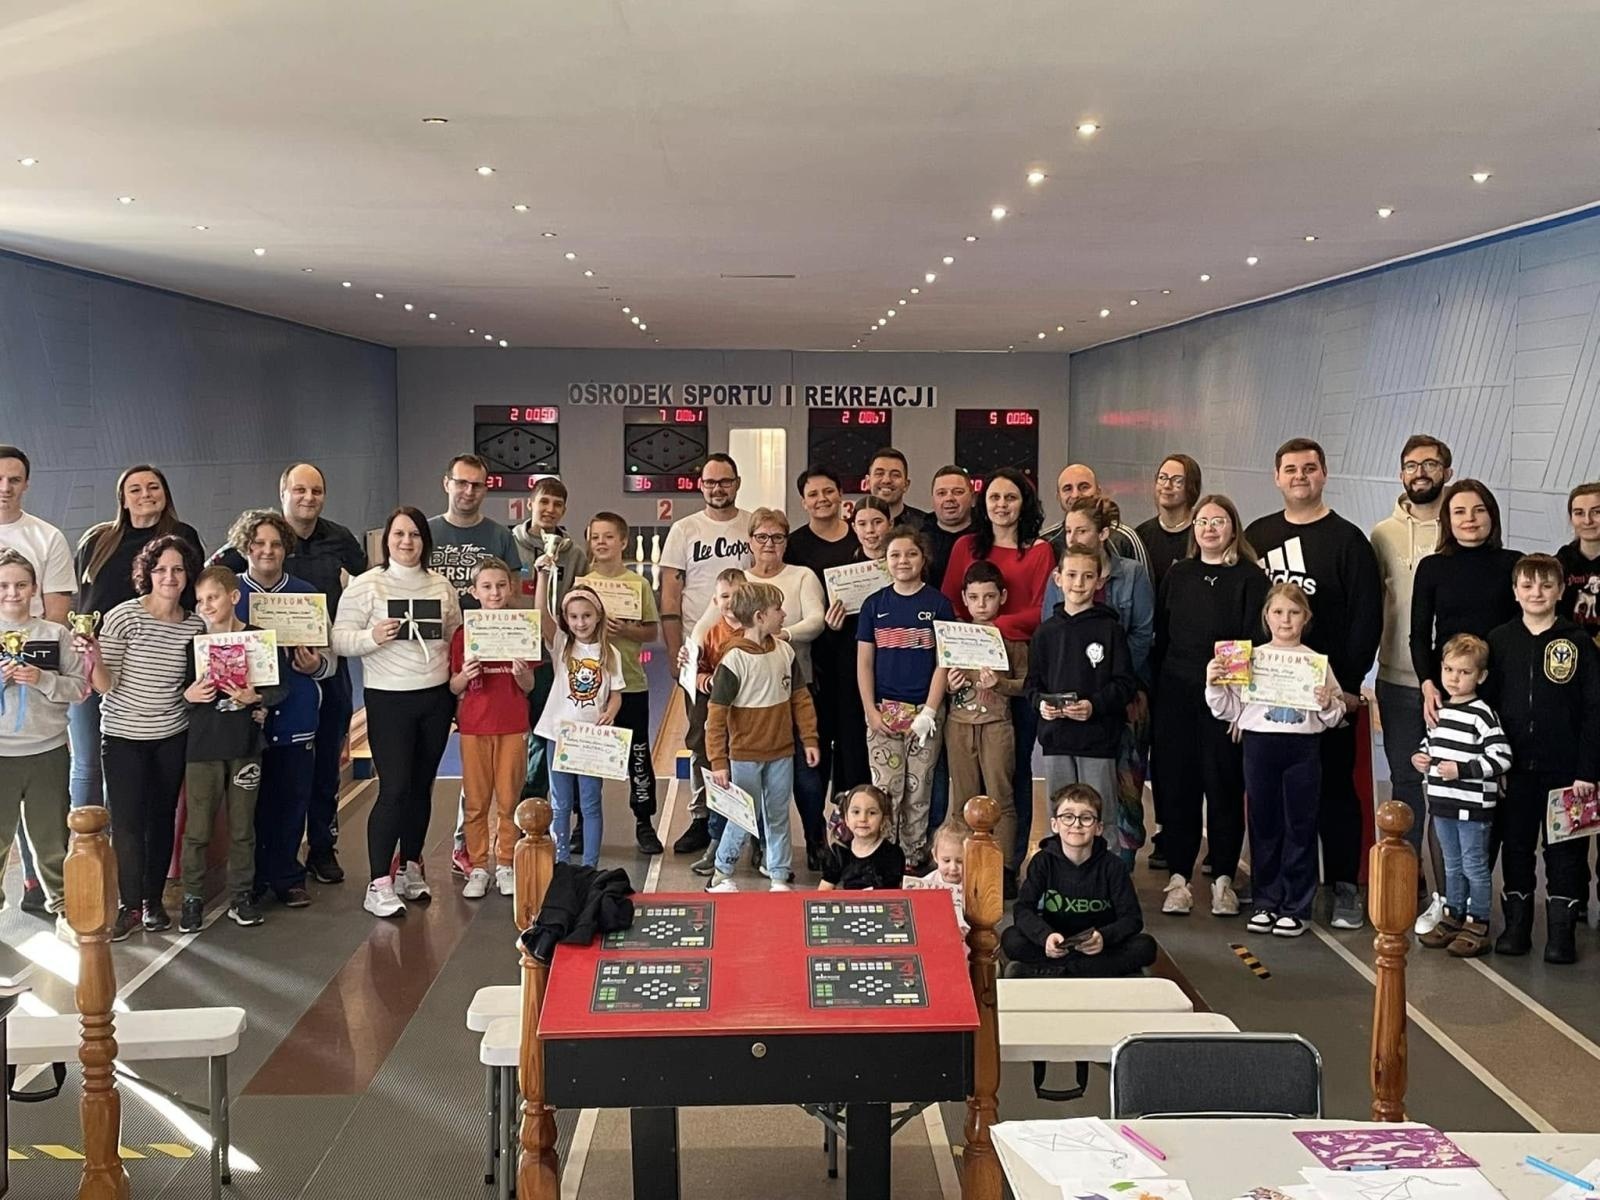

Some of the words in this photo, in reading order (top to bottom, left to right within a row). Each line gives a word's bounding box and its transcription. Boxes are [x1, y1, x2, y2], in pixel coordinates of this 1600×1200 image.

[568, 380, 672, 405] OŚRODEK
[684, 384, 772, 405] SPORTU
[785, 385, 793, 406] I
[805, 385, 934, 408] REKREACJI
[510, 408, 519, 421] 2
[659, 409, 667, 422] 7
[842, 411, 850, 423] 2
[510, 500, 524, 520] 1
[659, 500, 672, 520] 2
[842, 501, 855, 520] 3
[693, 540, 713, 562] Lee
[1065, 897, 1112, 913] XBOX
